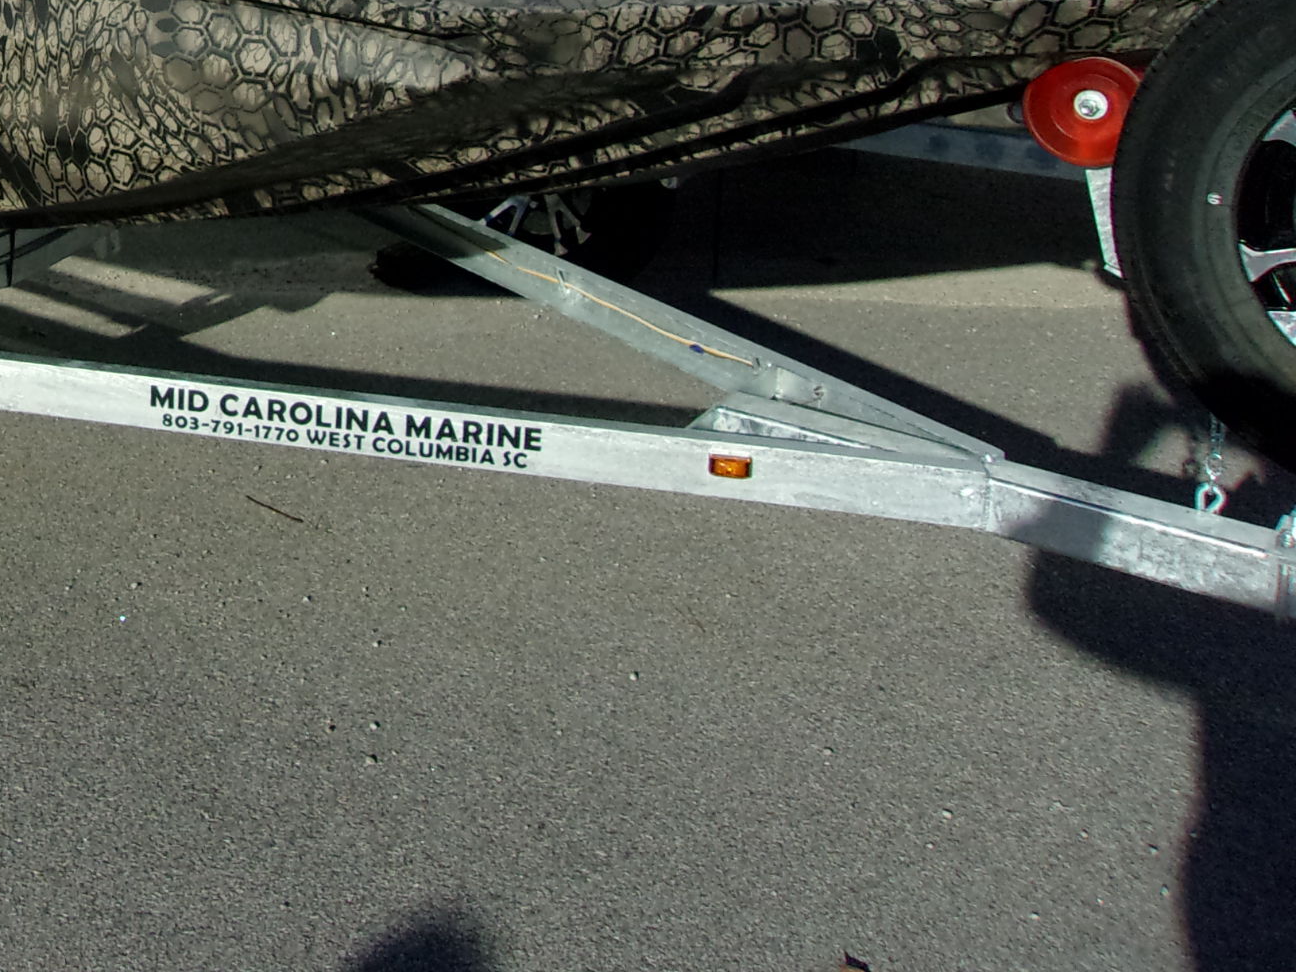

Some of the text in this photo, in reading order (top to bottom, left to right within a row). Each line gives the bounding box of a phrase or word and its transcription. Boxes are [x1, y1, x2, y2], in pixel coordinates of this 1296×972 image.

[150, 385, 542, 451] MID CAROLINA MARINE
[162, 413, 528, 469] 803-791-1770 WEST COLUMBIA SC
